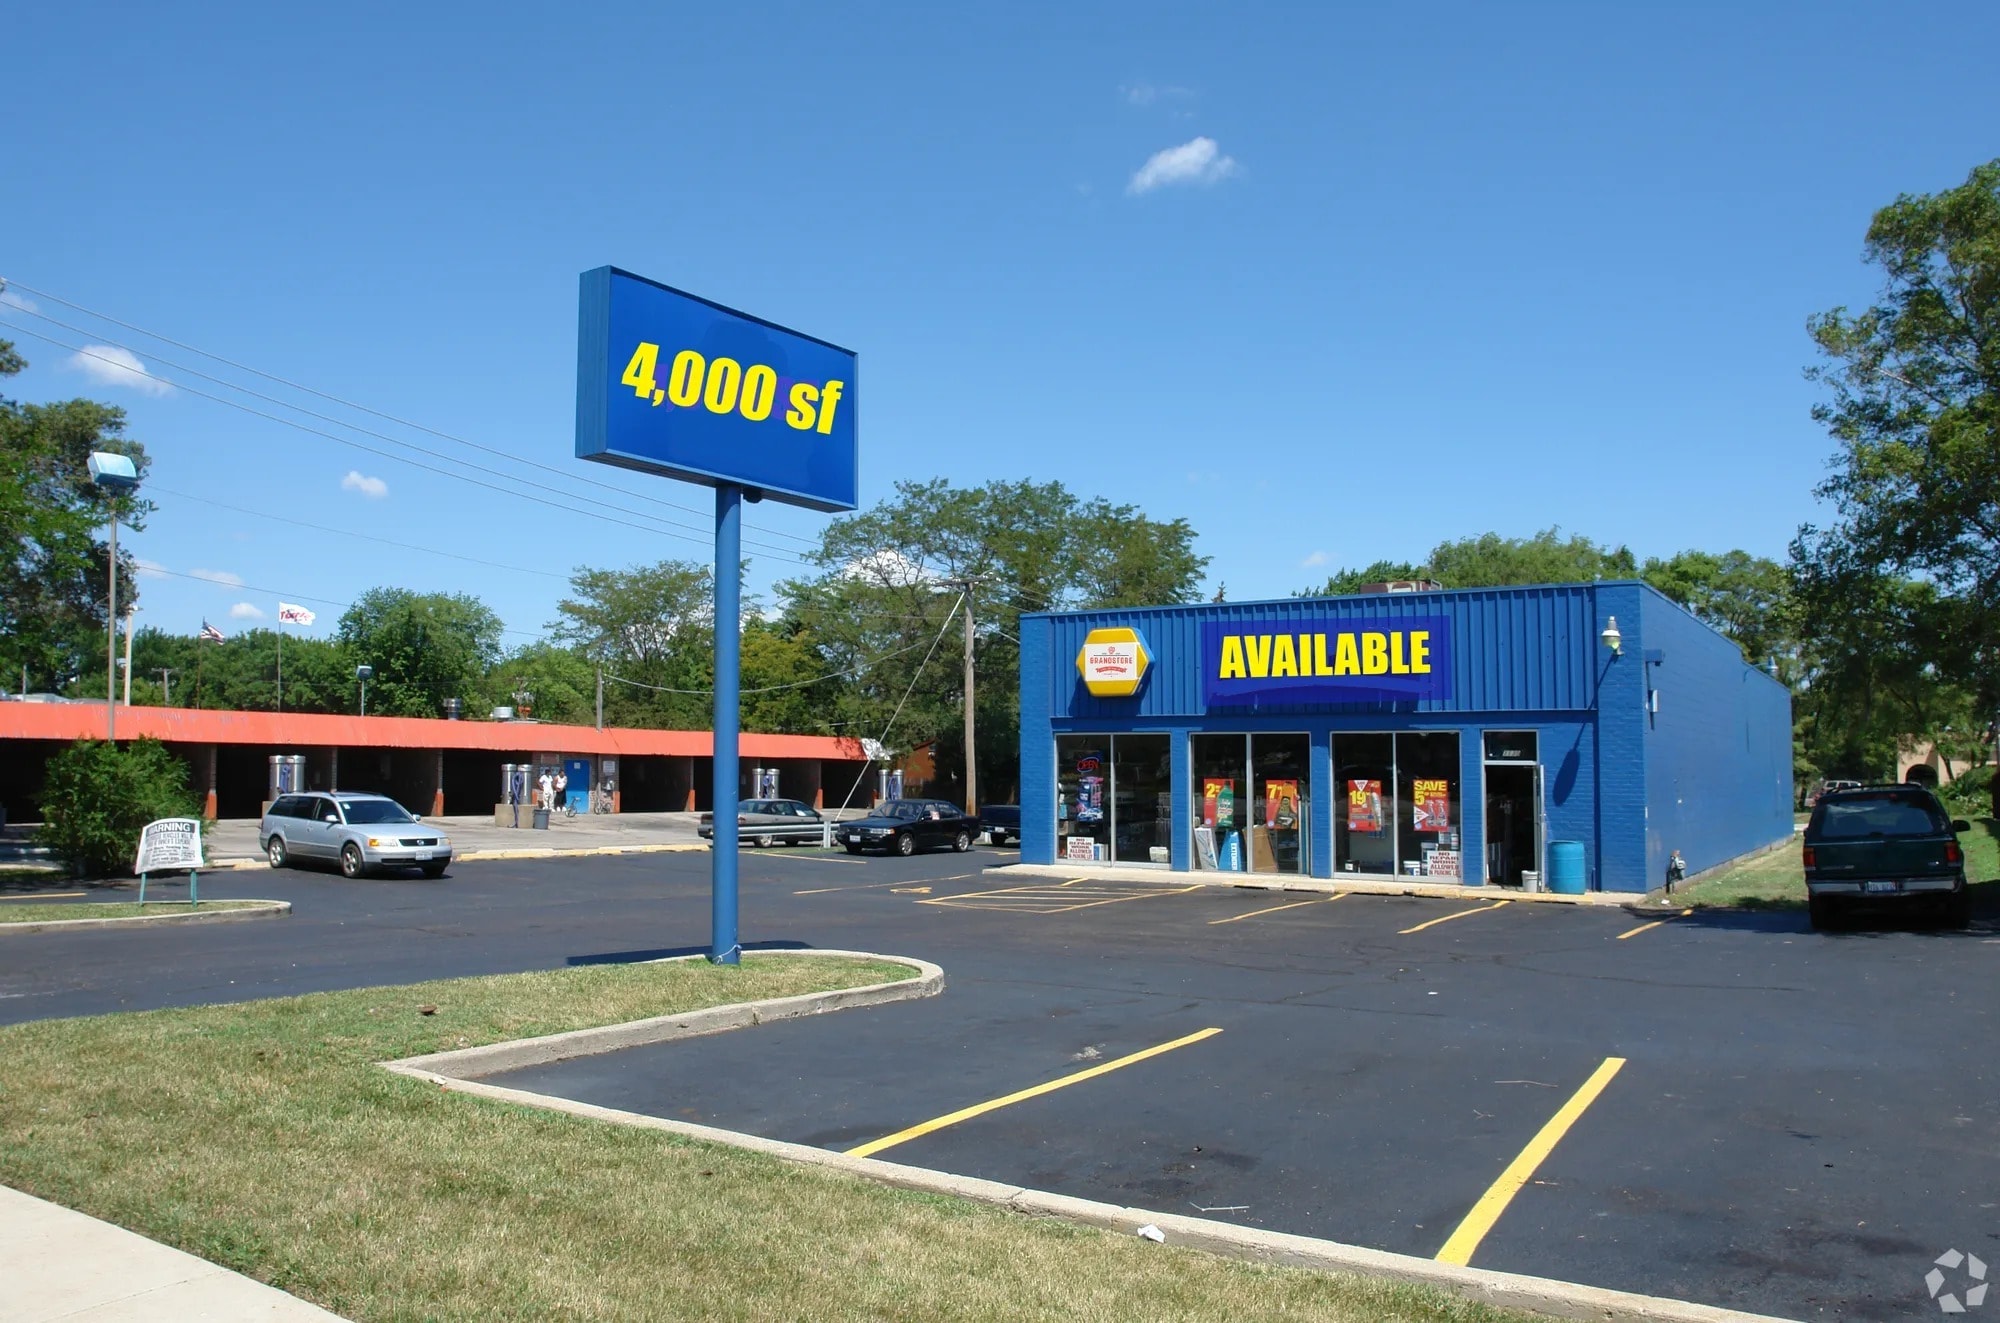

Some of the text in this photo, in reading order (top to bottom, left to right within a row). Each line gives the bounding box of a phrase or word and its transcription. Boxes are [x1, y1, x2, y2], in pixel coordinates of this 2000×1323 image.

[621, 341, 844, 435] 4,000 sf
[1219, 630, 1431, 679] AVAILABLE
[1077, 760, 1099, 769] OPEN
[1413, 780, 1447, 791] SAVE
